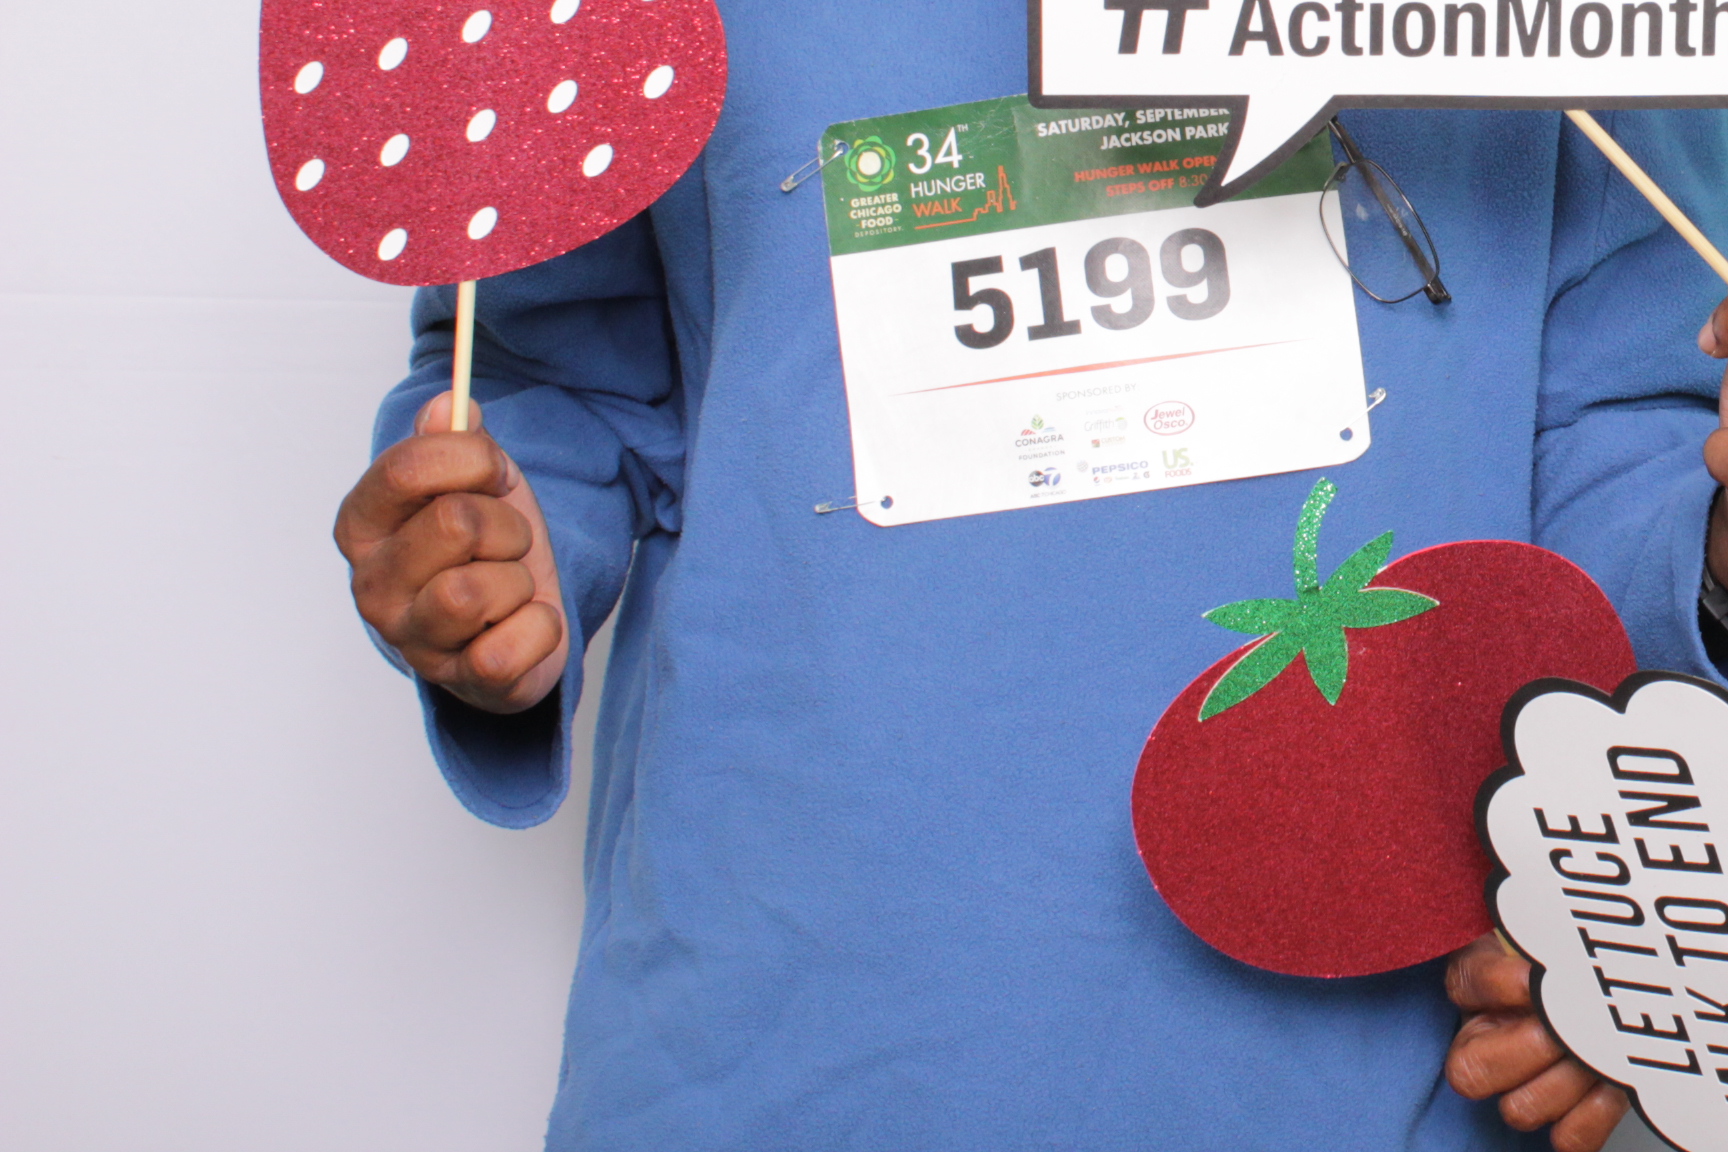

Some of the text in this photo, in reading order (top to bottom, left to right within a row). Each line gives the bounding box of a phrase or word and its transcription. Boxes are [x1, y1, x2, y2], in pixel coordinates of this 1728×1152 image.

[1037, 112, 1130, 137] SATURDAY,
[1100, 122, 1230, 150] JACKSON PARK
[1074, 165, 1135, 182] HUNGER
[1137, 159, 1180, 174] WALK
[911, 173, 986, 198] HUNGER
[1105, 174, 1208, 197] STEPS OFF 8:30
[850, 193, 899, 208] GREATER
[912, 198, 963, 218] WALK
[850, 204, 902, 219] CHICAGO
[861, 217, 894, 229] FOOD
[951, 228, 1231, 350] 5199
[1056, 384, 1122, 401] SPONSORED
[1150, 406, 1186, 421] Jewel
[1015, 434, 1065, 448] CONAGRA
[1018, 450, 1066, 461] FOUNDATION
[1092, 460, 1149, 475] PEPSICO
[1164, 468, 1192, 478] FOODS
[1606, 745, 1724, 875] END
[1533, 808, 1704, 1077] LETTUCE
